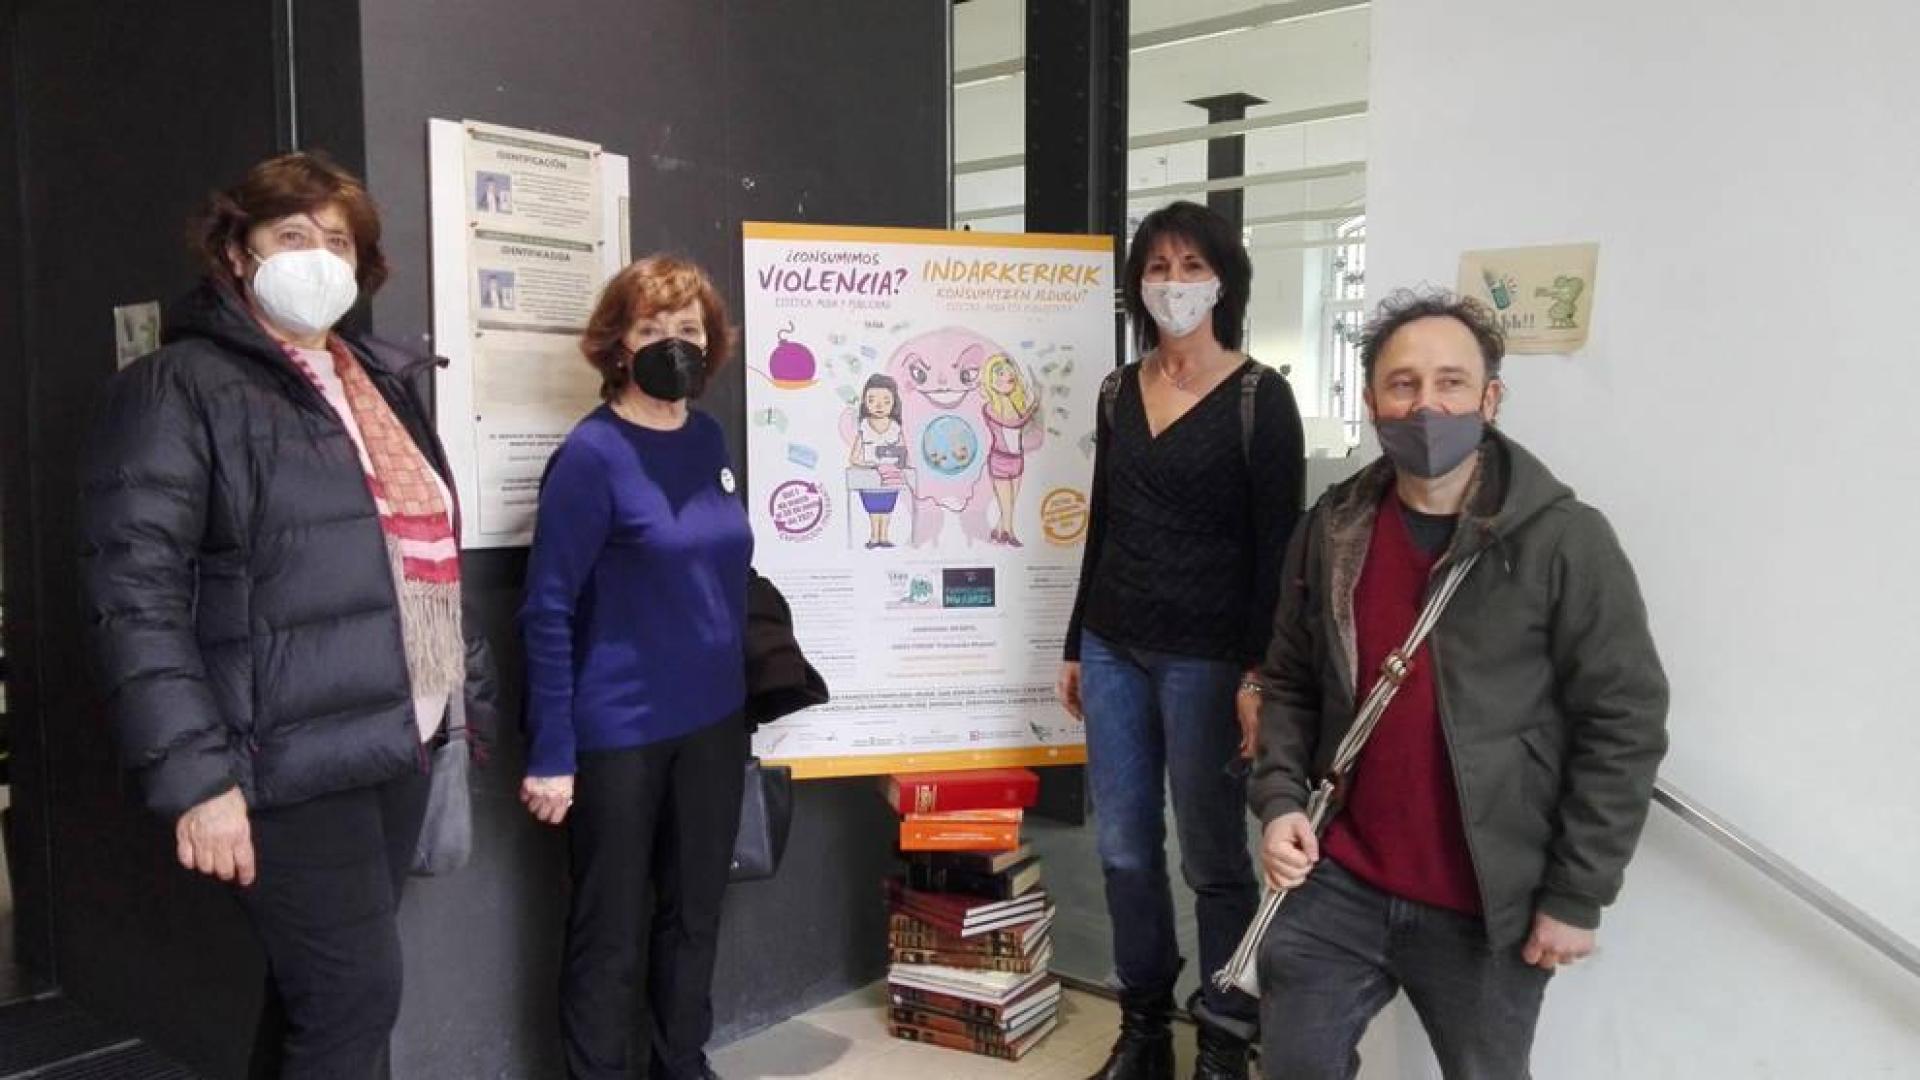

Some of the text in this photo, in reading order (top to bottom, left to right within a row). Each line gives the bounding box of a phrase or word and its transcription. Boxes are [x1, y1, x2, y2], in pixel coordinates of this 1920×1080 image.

[785, 250, 880, 266] ¿CONSUMIMOS
[922, 256, 1102, 285] INDARKERIRIK
[758, 264, 909, 296] VIOLENCIA?
